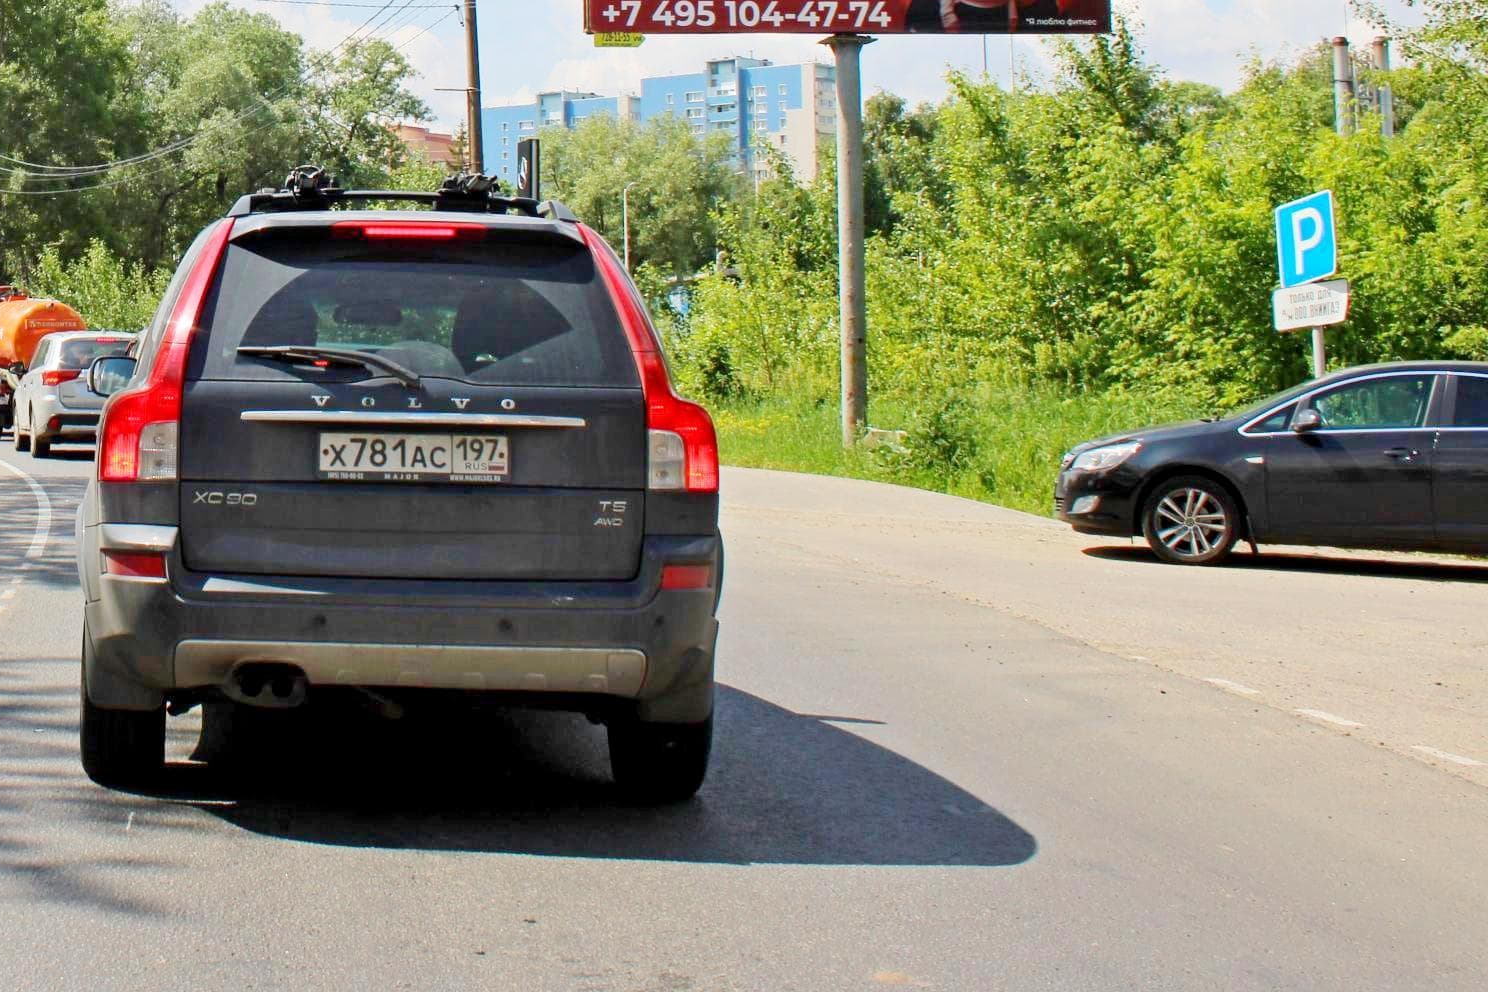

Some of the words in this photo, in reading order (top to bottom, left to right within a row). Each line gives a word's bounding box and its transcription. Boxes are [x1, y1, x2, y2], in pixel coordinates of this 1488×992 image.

[602, 0, 642, 27] +7
[652, 0, 716, 27] 495
[724, 0, 892, 28] 104-47-74
[1036, 17, 1066, 26] люблю
[1066, 17, 1097, 27] фитнес
[311, 395, 516, 410] VOLVO
[455, 438, 499, 461] 197
[464, 462, 488, 471] RUS
[384, 472, 420, 481] MAJOR
[599, 501, 627, 513] T5
[593, 517, 624, 526] AWD
